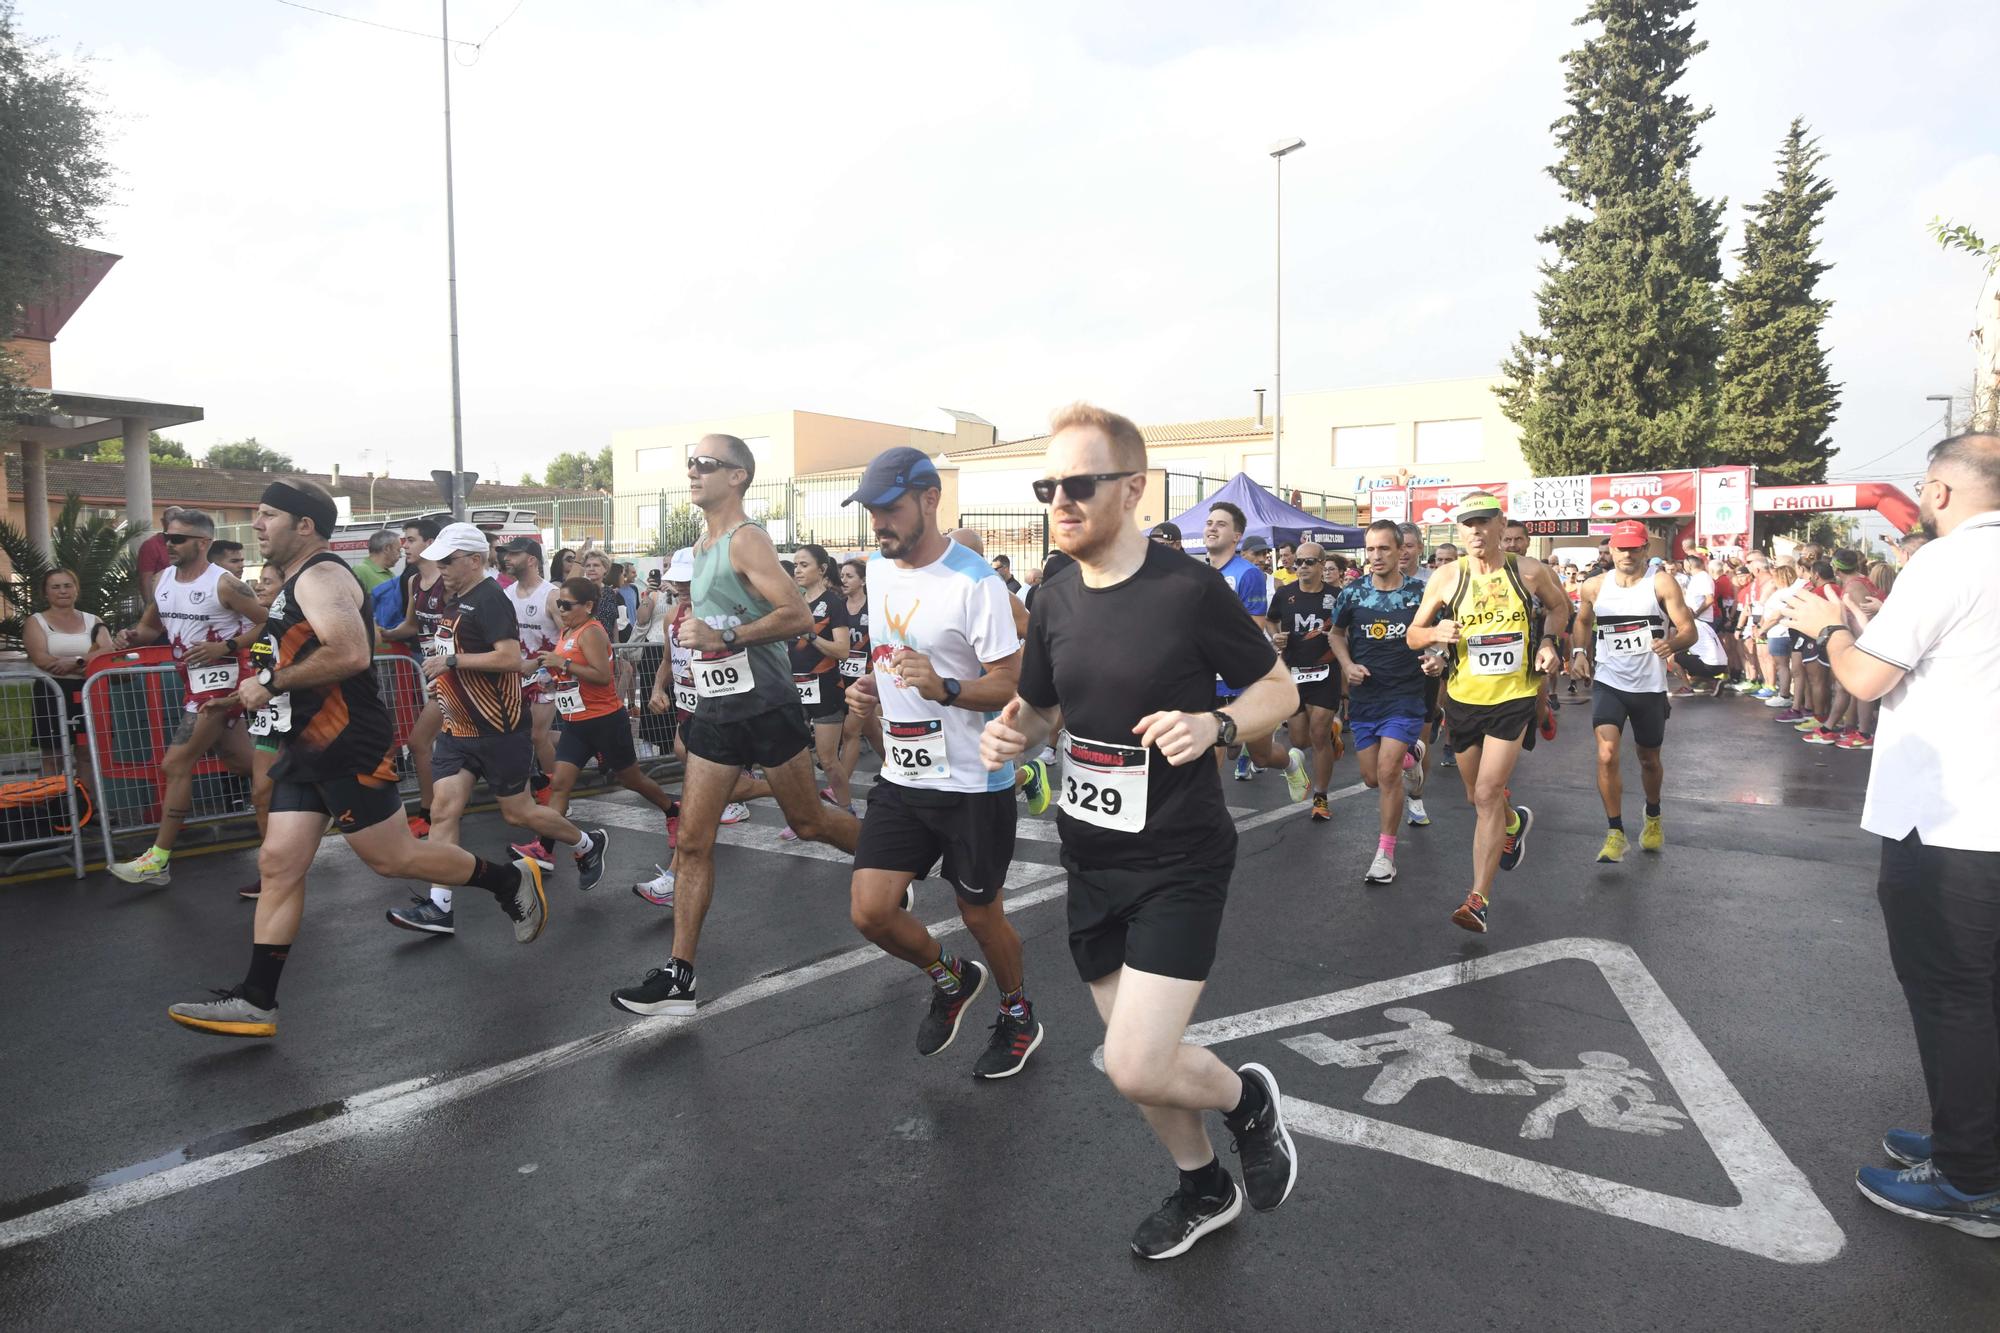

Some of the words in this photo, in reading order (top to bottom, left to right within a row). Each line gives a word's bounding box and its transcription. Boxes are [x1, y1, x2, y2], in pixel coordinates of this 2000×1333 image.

[1534, 479, 1584, 490] XXVIII
[1773, 494, 1834, 509] FAMU
[1613, 636, 1642, 650] 211
[1478, 651, 1515, 667] 070
[839, 661, 859, 673] 275
[198, 670, 231, 686] 129
[701, 667, 739, 688] 109
[557, 695, 575, 708] 191
[891, 745, 932, 769] 626
[1067, 775, 1122, 815] 329
